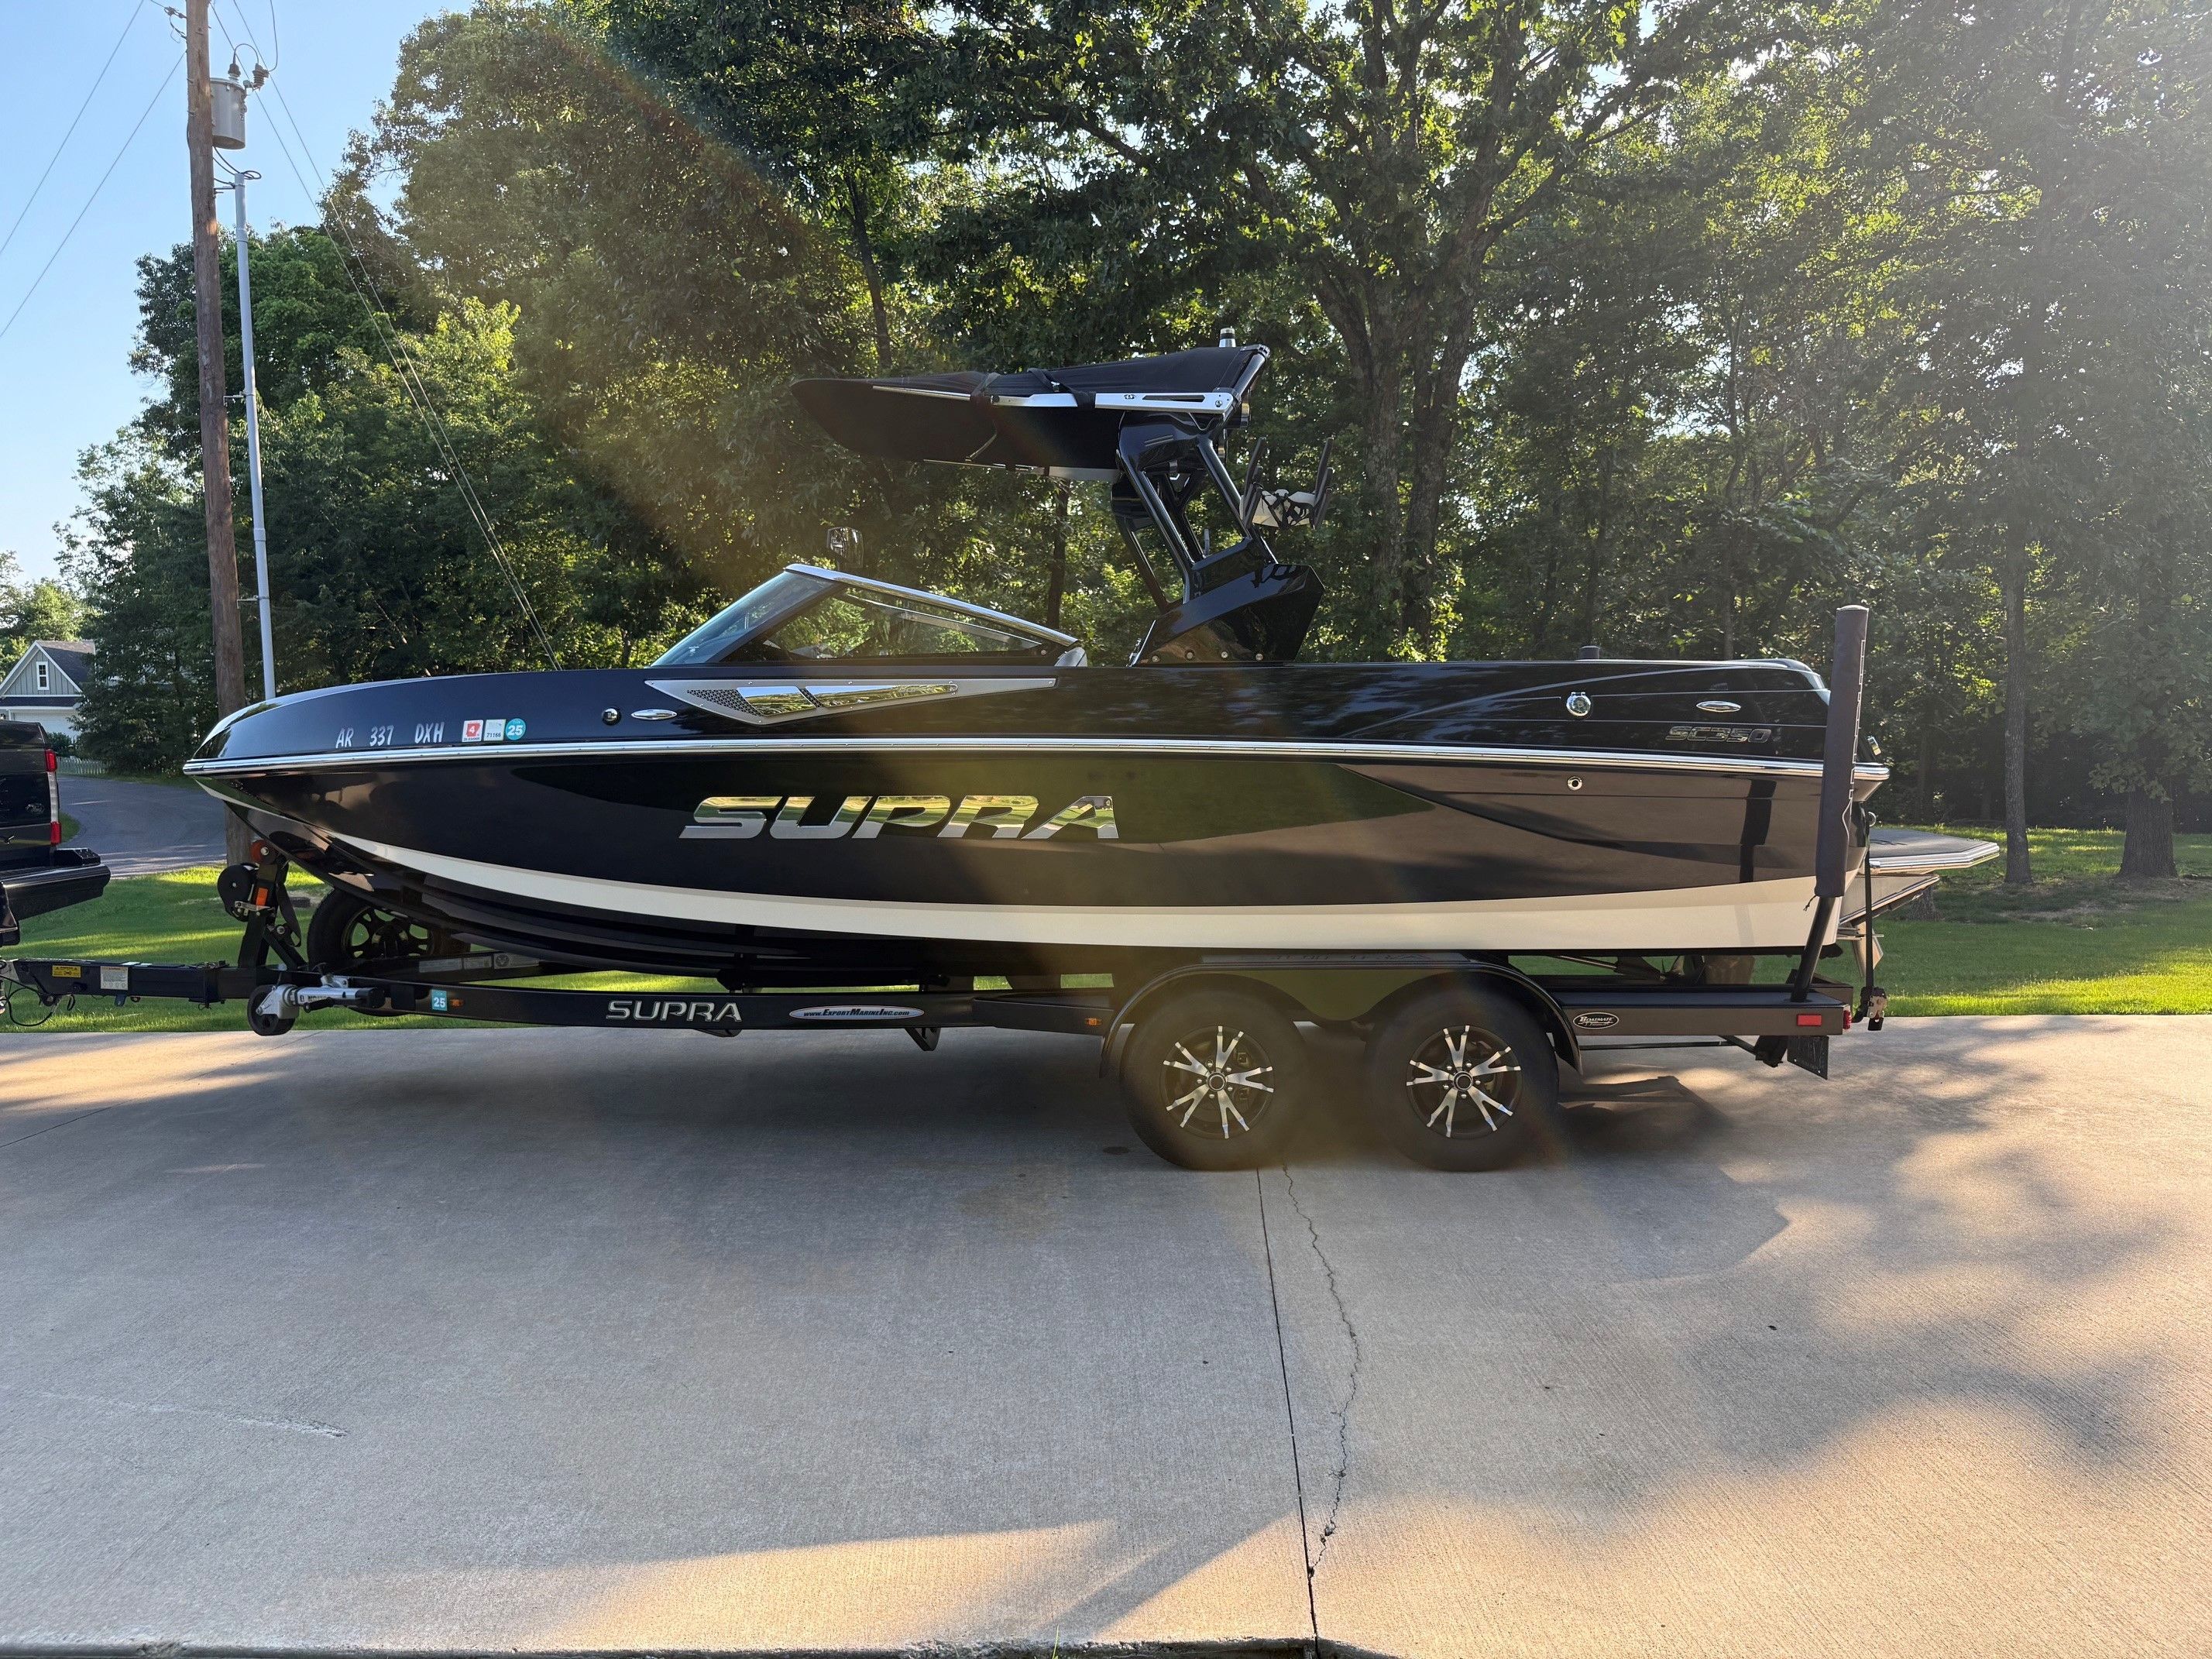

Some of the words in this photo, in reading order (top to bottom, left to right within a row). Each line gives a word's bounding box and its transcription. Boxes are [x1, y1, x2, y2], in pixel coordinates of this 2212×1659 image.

[335, 726, 354, 748] AR
[369, 725, 394, 747] 337
[414, 721, 445, 744] DXH
[508, 725, 524, 736] 25
[1665, 726, 1771, 743] SC350
[678, 795, 1119, 839] SUPRA
[434, 997, 446, 1008] 25
[606, 1001, 742, 1022] SUPRA
